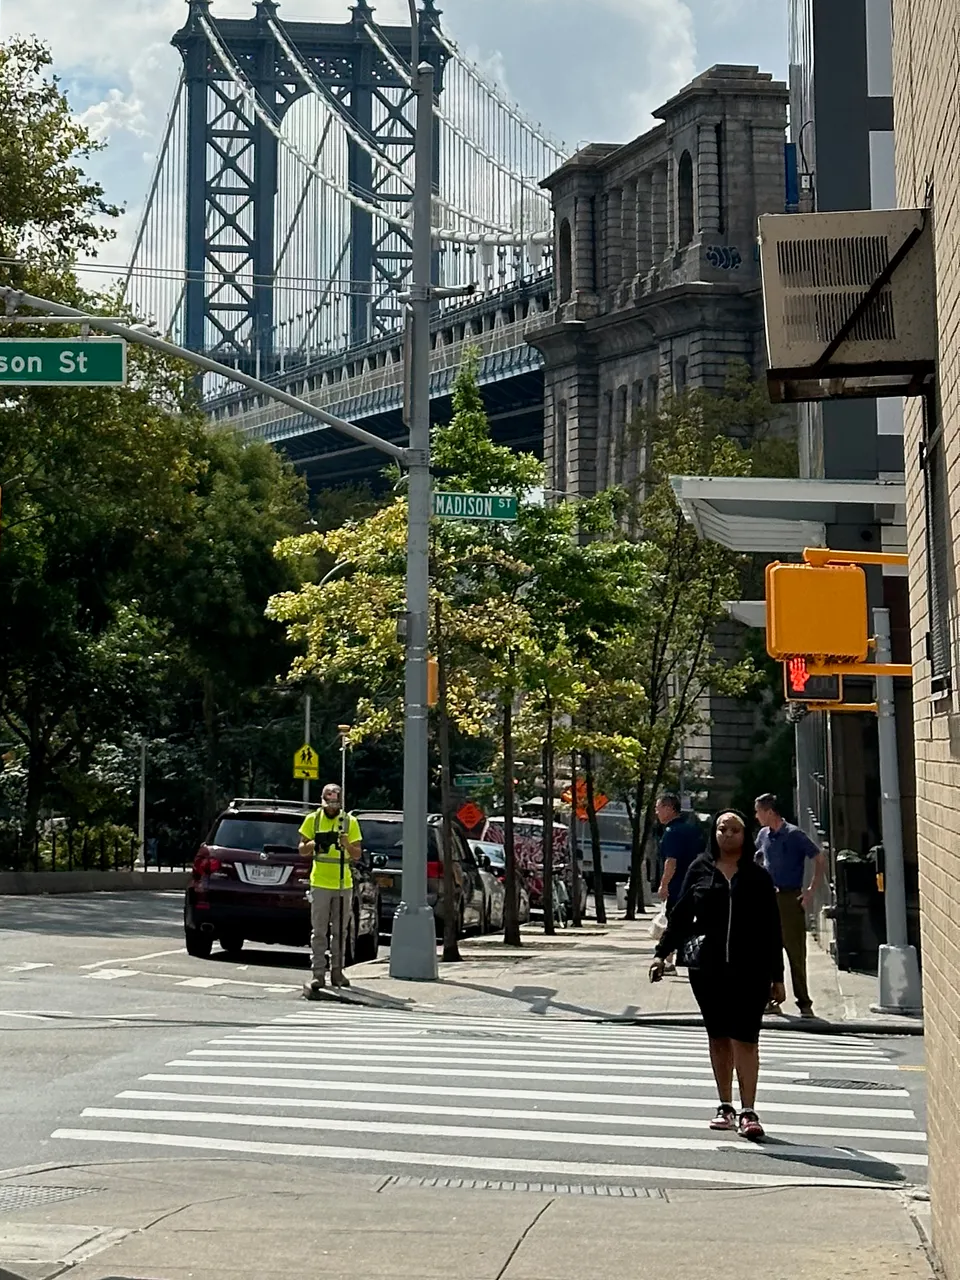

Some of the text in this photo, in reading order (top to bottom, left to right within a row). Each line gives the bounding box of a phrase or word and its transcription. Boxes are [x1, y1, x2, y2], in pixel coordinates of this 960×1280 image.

[59, 350, 88, 373] St
[435, 495, 512, 516] MADISON ST
